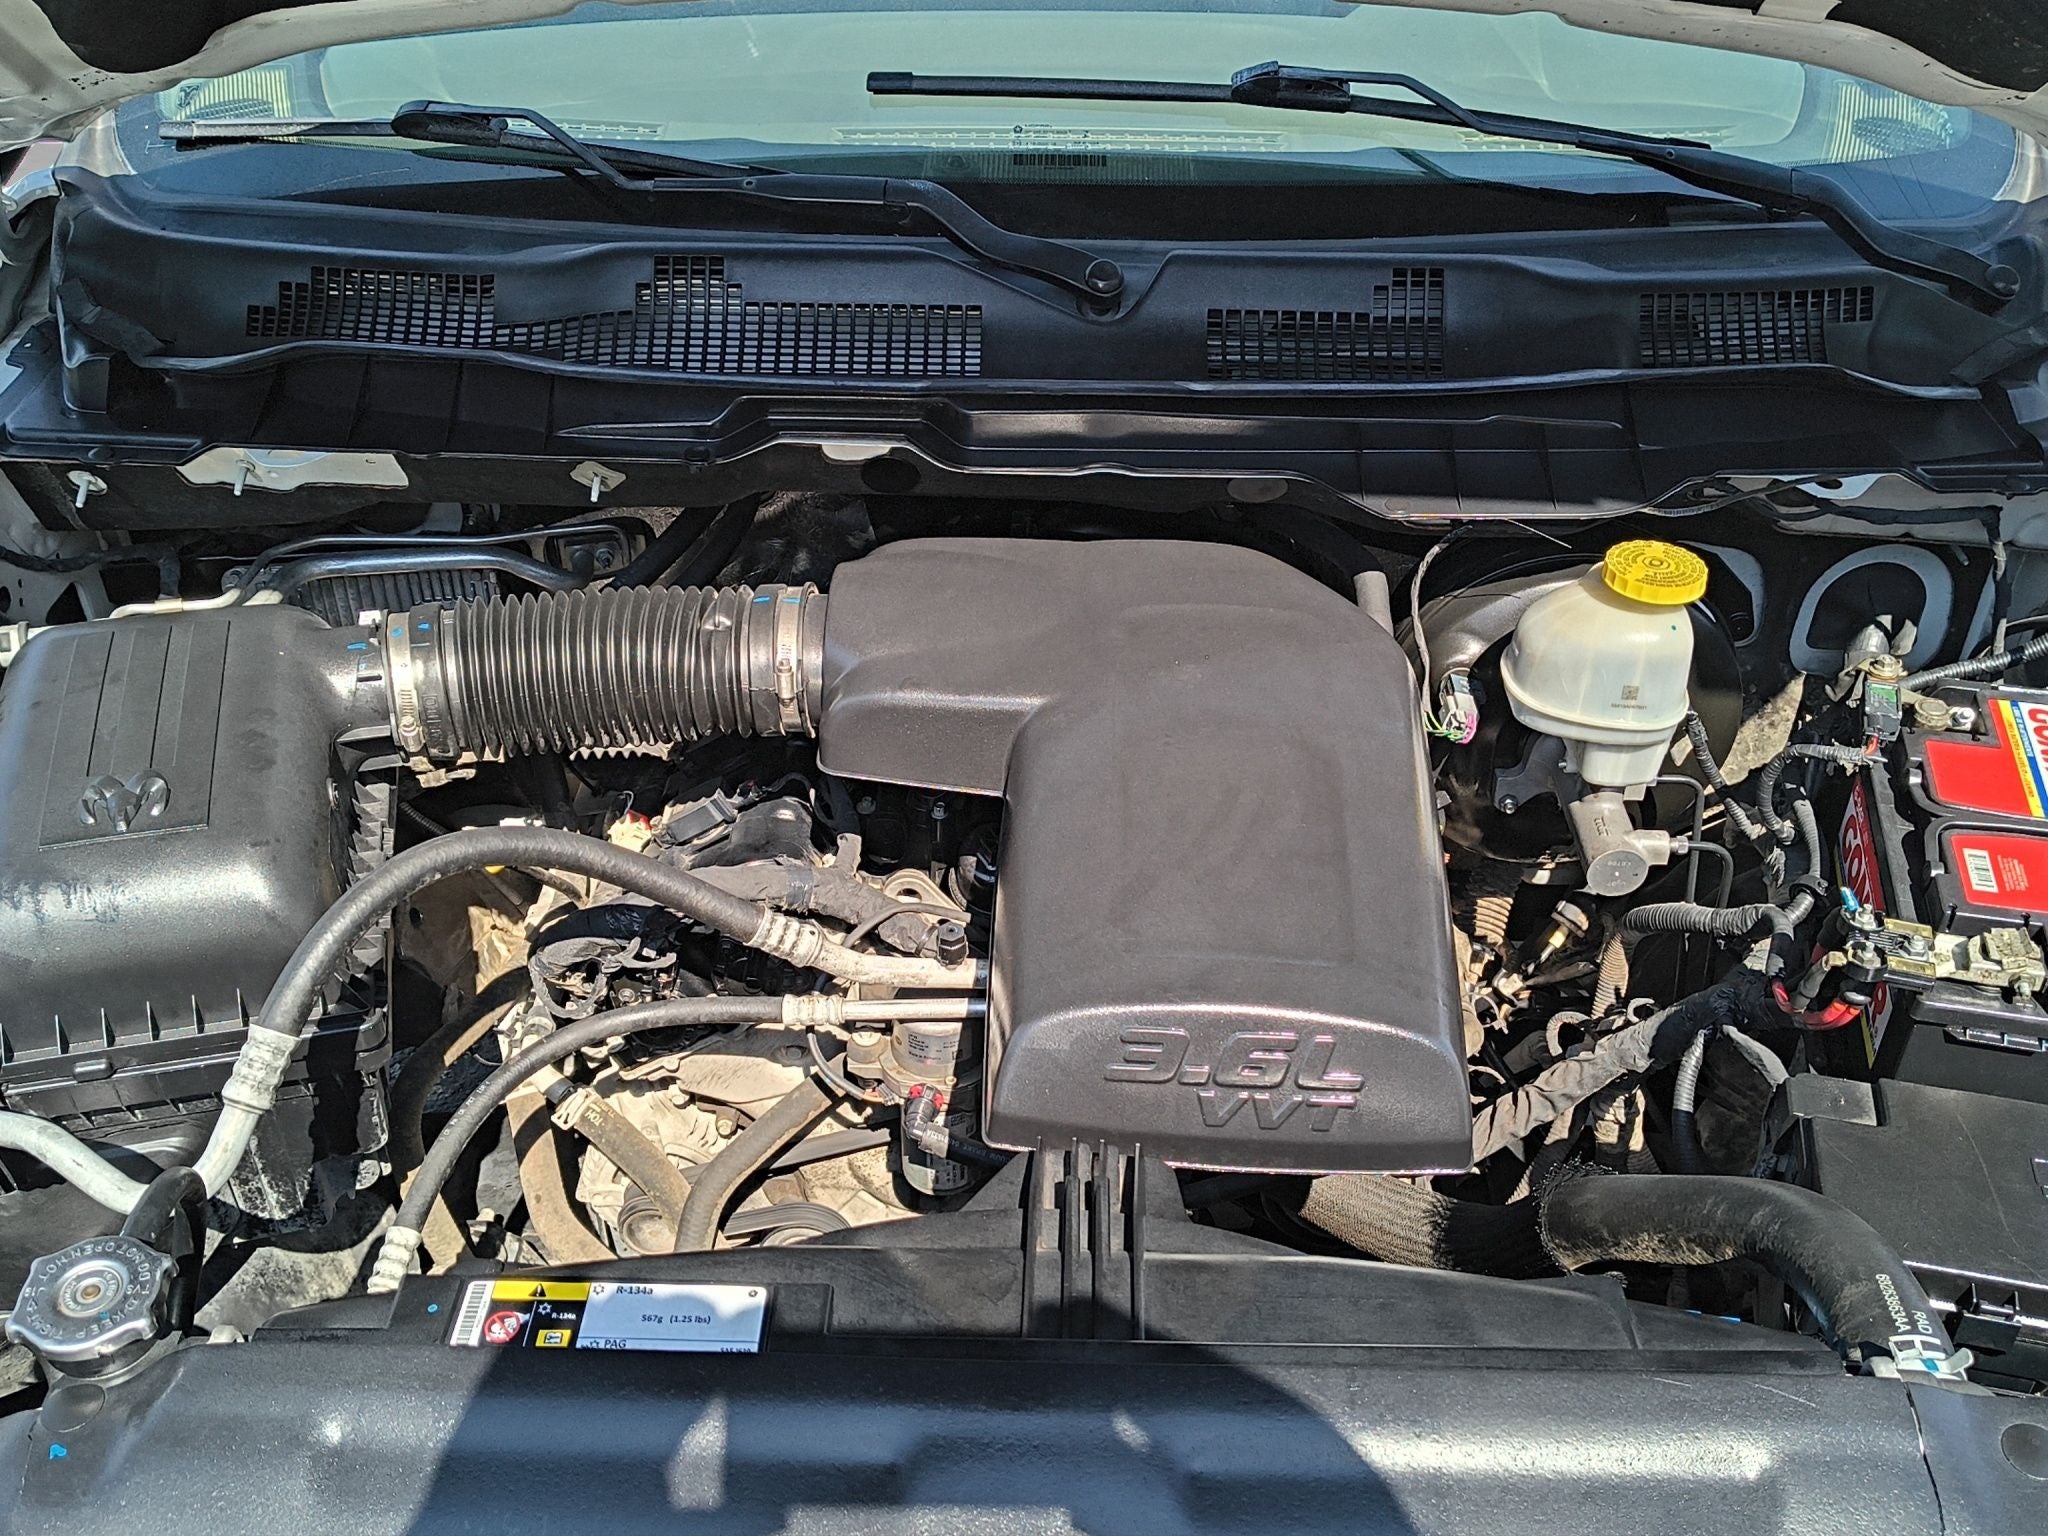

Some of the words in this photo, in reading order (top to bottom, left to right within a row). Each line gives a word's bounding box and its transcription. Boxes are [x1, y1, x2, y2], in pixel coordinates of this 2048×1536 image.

[1103, 1026, 1365, 1091] 3.6L
[1197, 1090, 1357, 1133] VVT
[71, 1241, 115, 1260] OPEN
[39, 1255, 68, 1282] HOT
[126, 1284, 150, 1296] TVS
[616, 1285, 653, 1295] R-134a
[26, 1314, 64, 1340] TIGHT
[76, 1309, 126, 1339] KEEP
[641, 1313, 664, 1324] 567g
[669, 1314, 693, 1324] (1.25
[694, 1314, 712, 1325] lbs)
[1911, 1310, 1933, 1334] RAD
[604, 1339, 627, 1349] PAG
